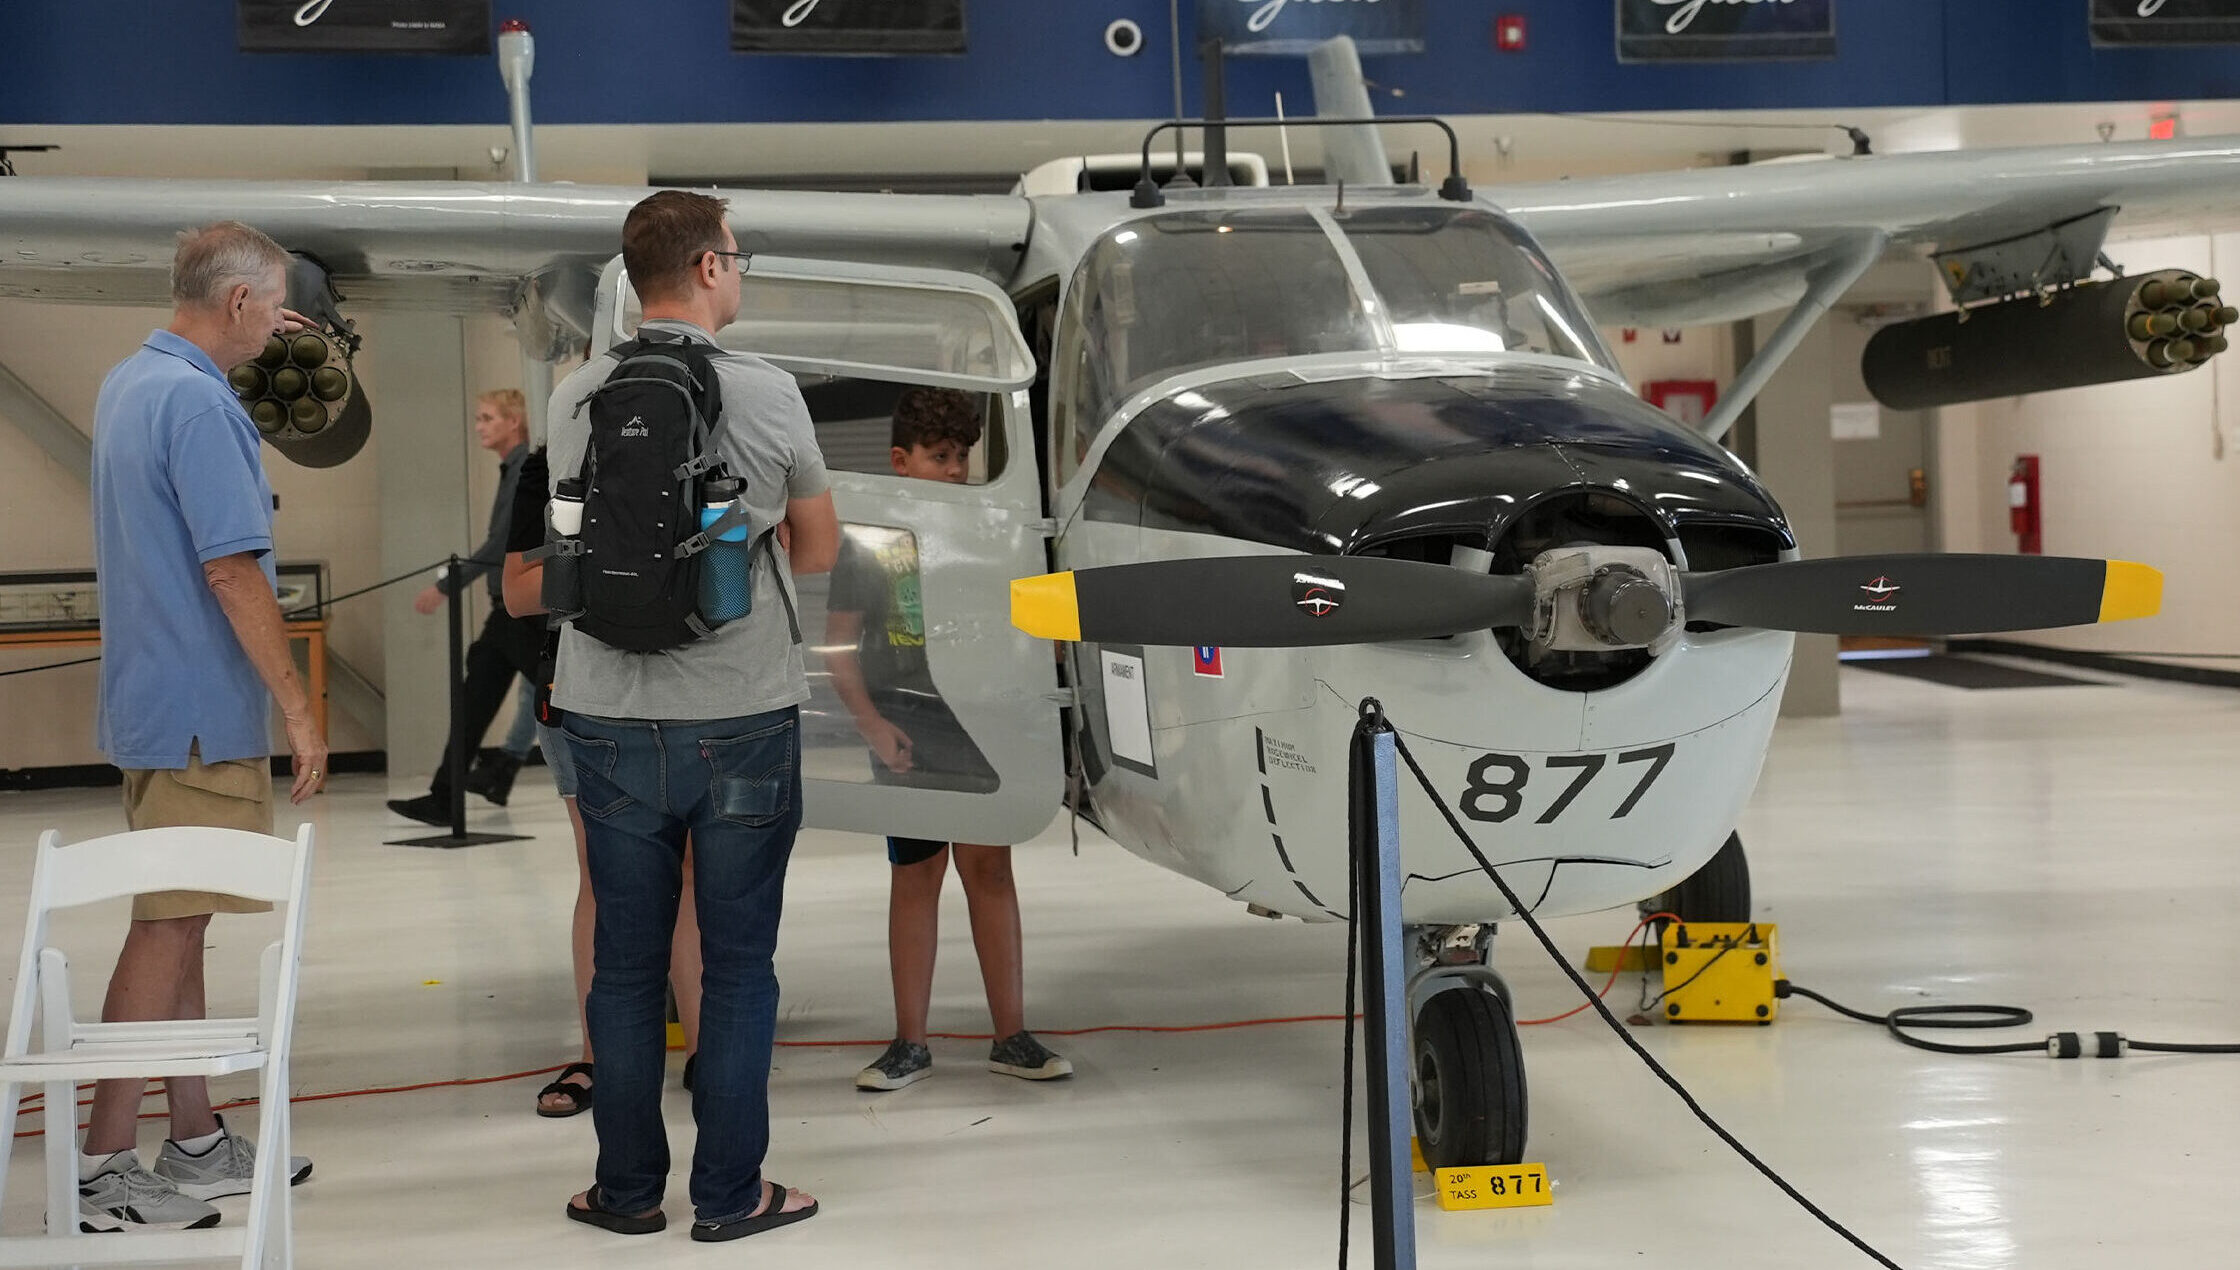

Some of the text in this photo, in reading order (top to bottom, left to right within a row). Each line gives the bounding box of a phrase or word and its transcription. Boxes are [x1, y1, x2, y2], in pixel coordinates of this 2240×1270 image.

[1269, 756, 1316, 773] DEFLECTION
[1459, 742, 1676, 825] 877
[1449, 1173, 1471, 1184] 20th
[1490, 1173, 1541, 1195] 877
[1449, 1189, 1477, 1199] TASS
